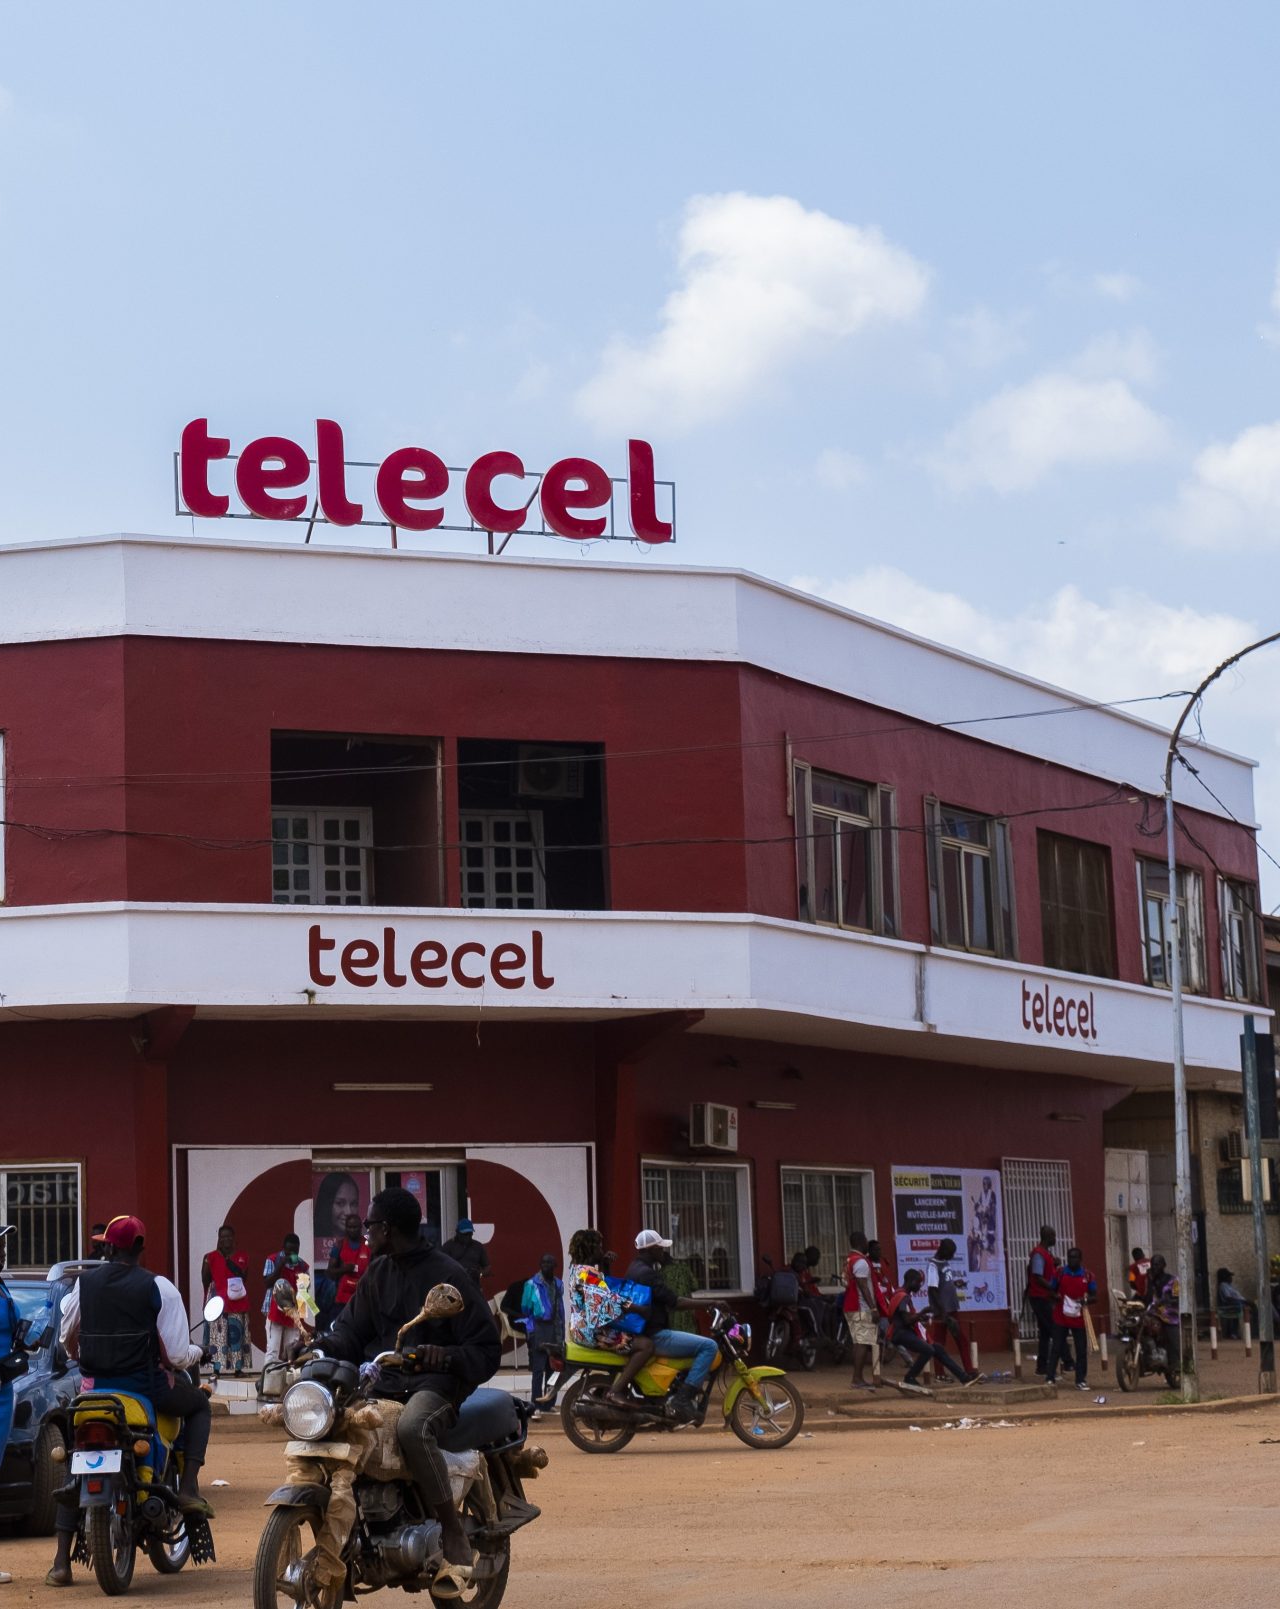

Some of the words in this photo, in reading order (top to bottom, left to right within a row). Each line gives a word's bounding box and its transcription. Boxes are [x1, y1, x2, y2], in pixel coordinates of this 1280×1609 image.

[179, 417, 673, 544] telecel
[308, 924, 554, 990] telecel
[1022, 978, 1097, 1040] telecel
